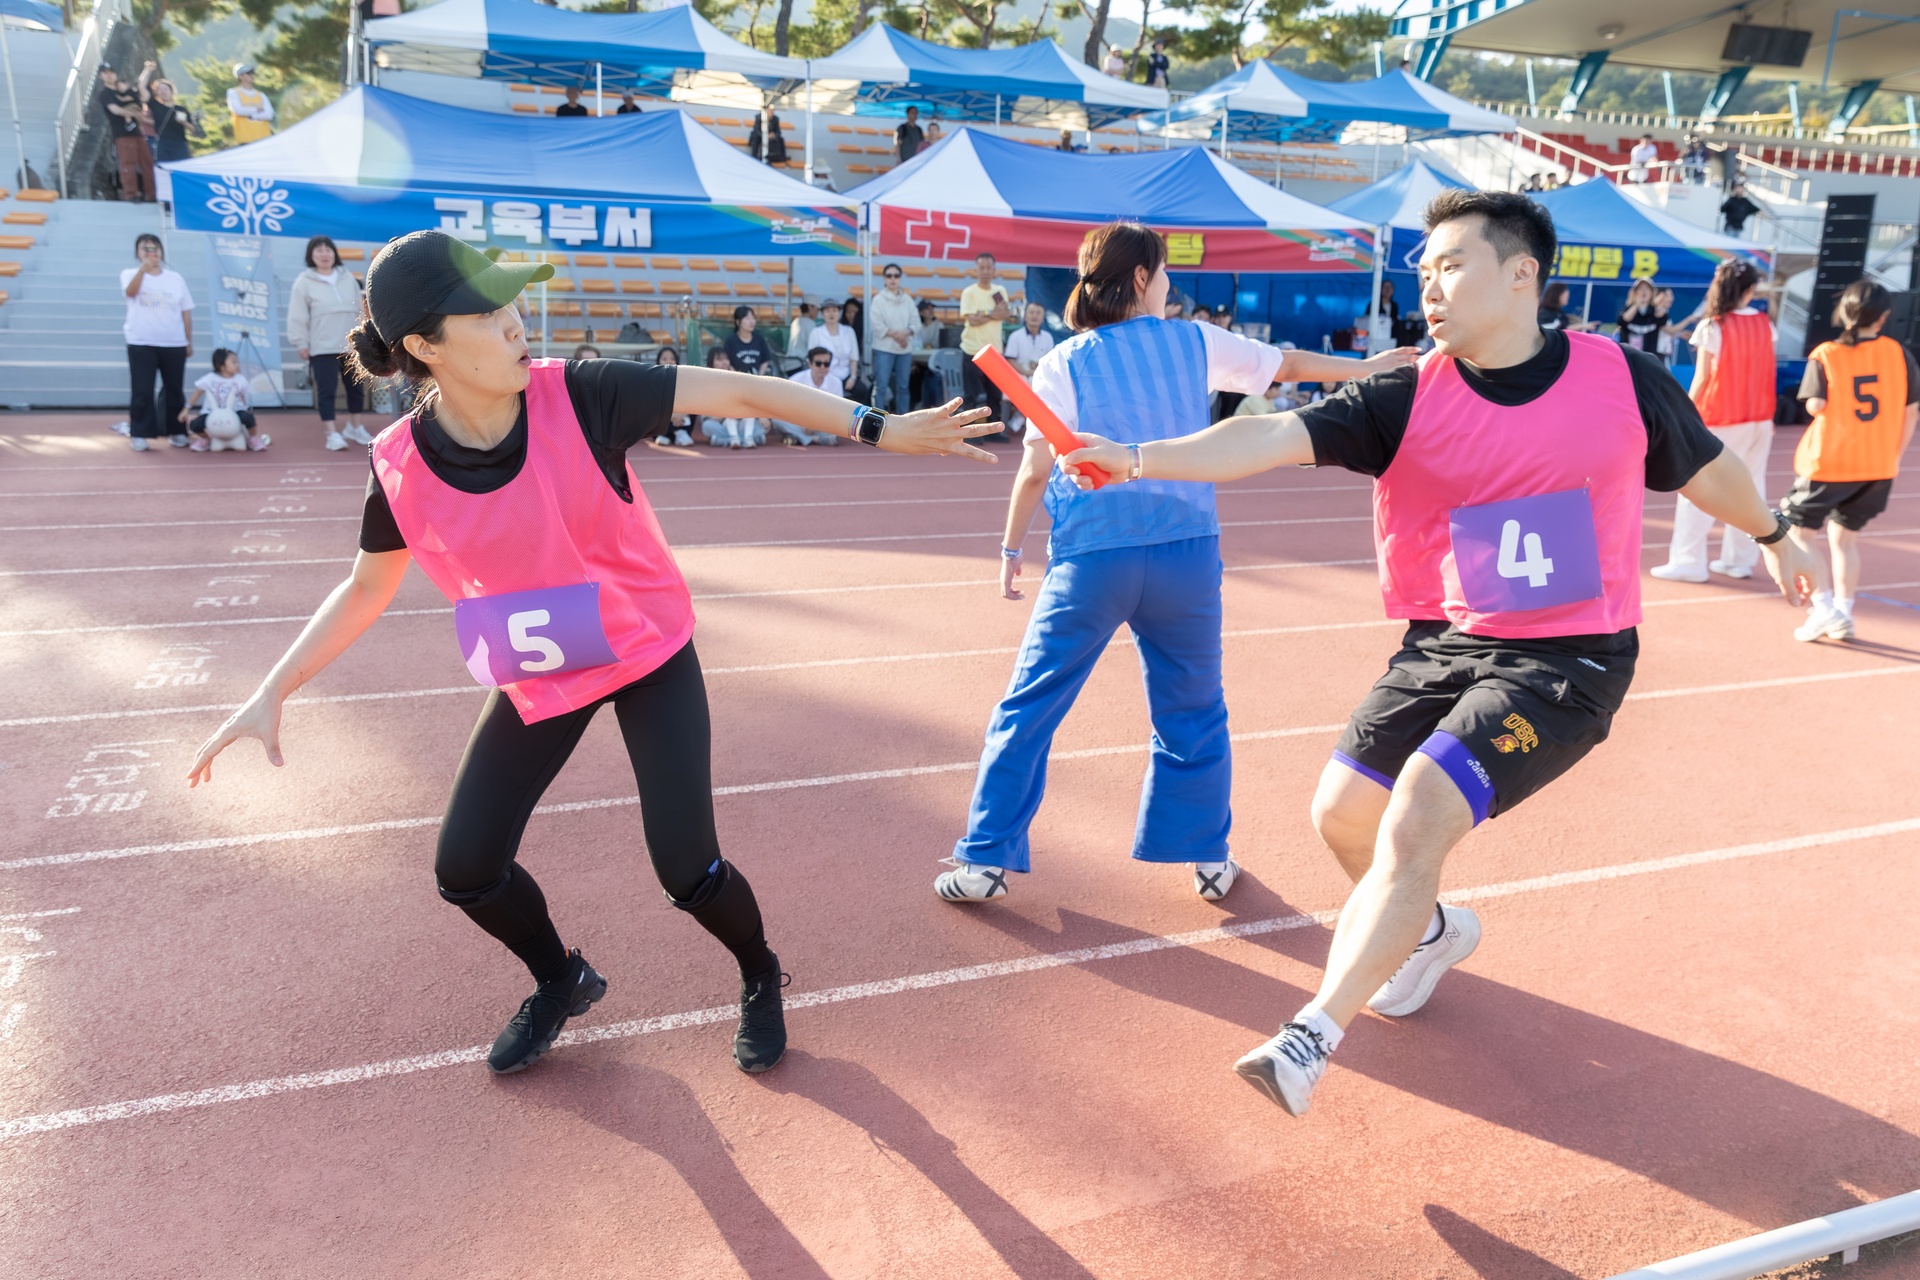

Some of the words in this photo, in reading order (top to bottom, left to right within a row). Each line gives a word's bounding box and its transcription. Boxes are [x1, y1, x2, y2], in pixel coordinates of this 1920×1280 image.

[434, 197, 652, 248] 교육부서
[1550, 245, 1622, 279] 비팀
[1630, 249, 1660, 279] B
[1853, 374, 1879, 422] 5
[1497, 519, 1554, 587] 4
[507, 608, 566, 672] 5
[1502, 712, 1539, 754] USC
[1466, 758, 1490, 789] adidas
